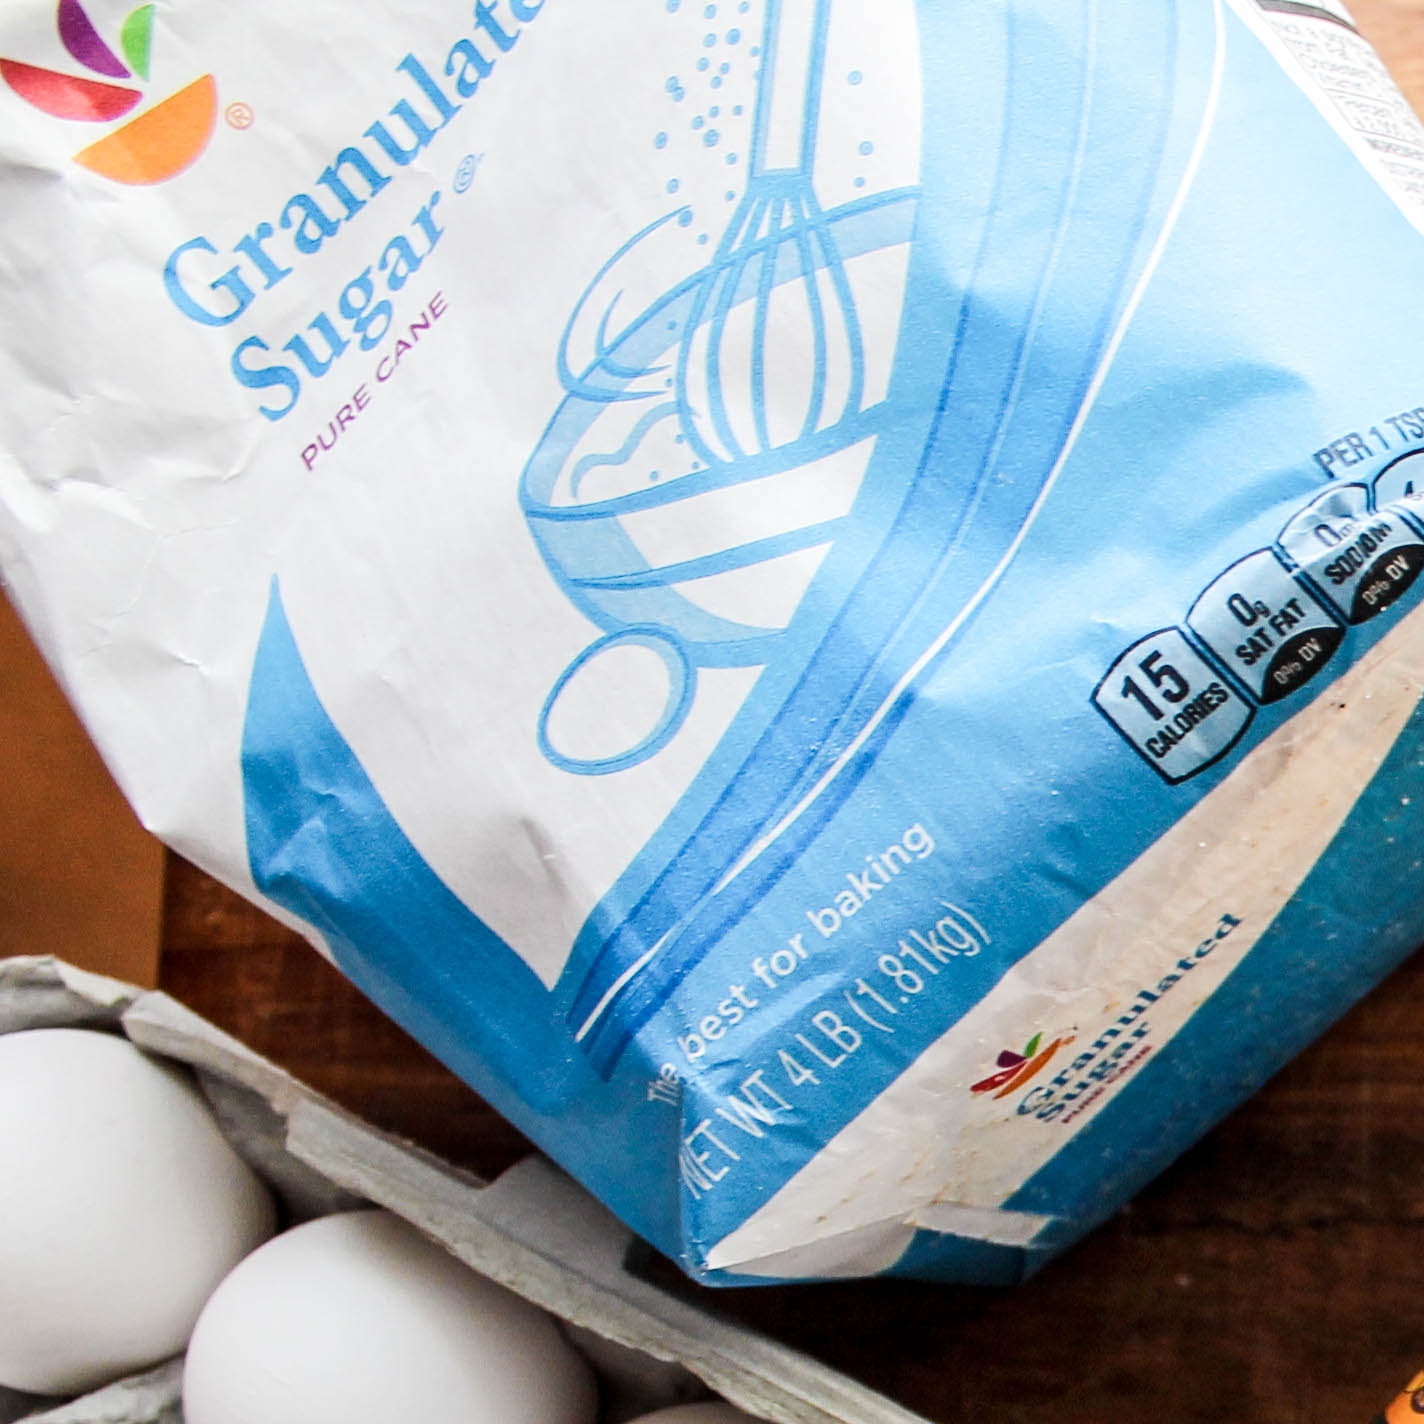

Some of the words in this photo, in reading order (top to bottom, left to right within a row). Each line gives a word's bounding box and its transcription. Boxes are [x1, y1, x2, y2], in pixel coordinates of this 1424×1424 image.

[231, 188, 446, 423] Sugar
[300, 387, 372, 472] PURE
[375, 290, 450, 385] CANE
[1312, 431, 1375, 480] PER
[1369, 426, 1390, 450] 1
[1385, 554, 1411, 581] DV
[1235, 626, 1276, 667] SAT
[1268, 597, 1307, 636] FAT
[1297, 636, 1324, 663] DV
[1120, 649, 1190, 722] 15
[1144, 681, 1230, 759] CALORIES
[646, 1061, 684, 1107] The
[676, 982, 758, 1063] best
[752, 933, 811, 997] for
[808, 820, 938, 941] baking
[842, 899, 992, 1038] (1.81kg)
[794, 1006, 863, 1070] LB
[1016, 911, 1244, 1118] Granulated
[714, 1068, 795, 1139] WT
[777, 1048, 821, 1087] 4
[1035, 1020, 1152, 1125] Sugar
[678, 1118, 741, 1200] NET
